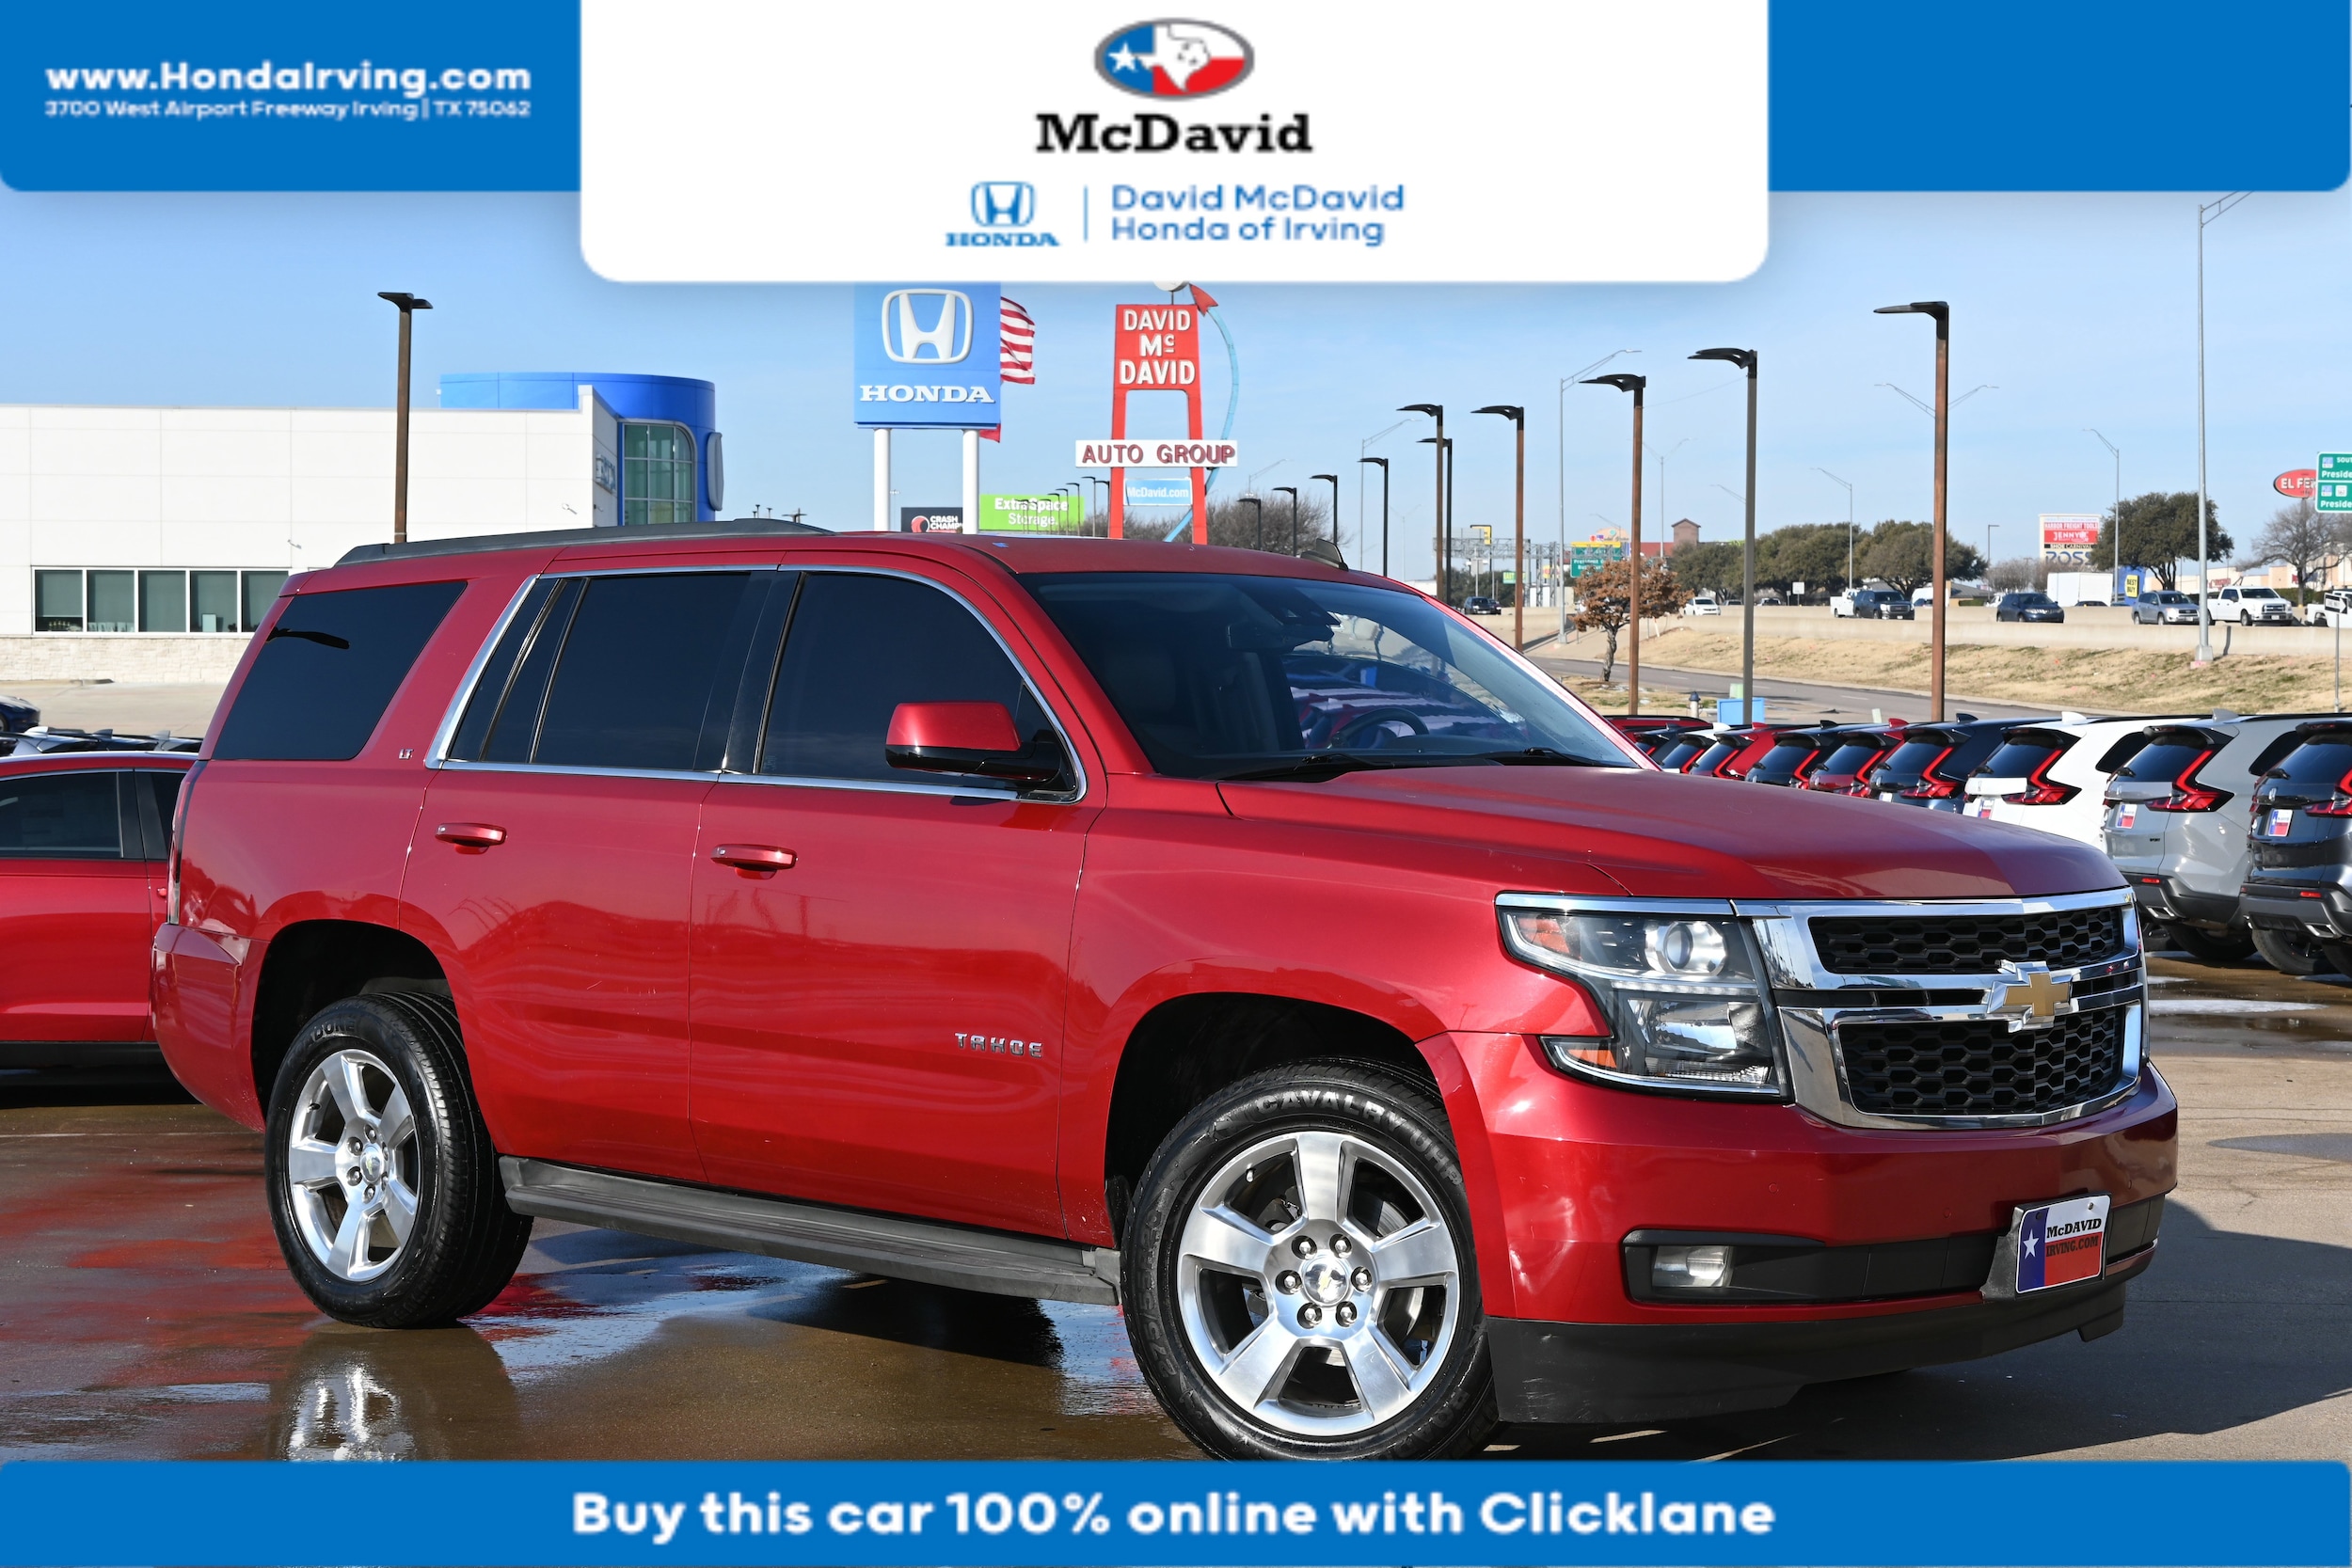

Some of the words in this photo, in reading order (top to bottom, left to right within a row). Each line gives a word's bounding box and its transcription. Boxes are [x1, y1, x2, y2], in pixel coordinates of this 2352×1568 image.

[1122, 309, 1192, 332] DAVID
[1119, 359, 1197, 386] DAVID
[859, 384, 995, 404] HONDA
[1082, 444, 1144, 465] AUTO
[1156, 444, 1236, 464] GROUP
[1127, 486, 1189, 498] McDavid.com
[2280, 478, 2295, 489] EL
[994, 497, 1028, 511] Extra
[1028, 497, 1068, 514] Space
[399, 749, 414, 759] LT
[954, 1032, 1042, 1058] TAHOE
[1255, 1089, 1407, 1132] CAVALRY
[1409, 1126, 1464, 1186] UHP
[2046, 1218, 2102, 1239] McDAVID
[2045, 1236, 2099, 1257] IRVING.COM
